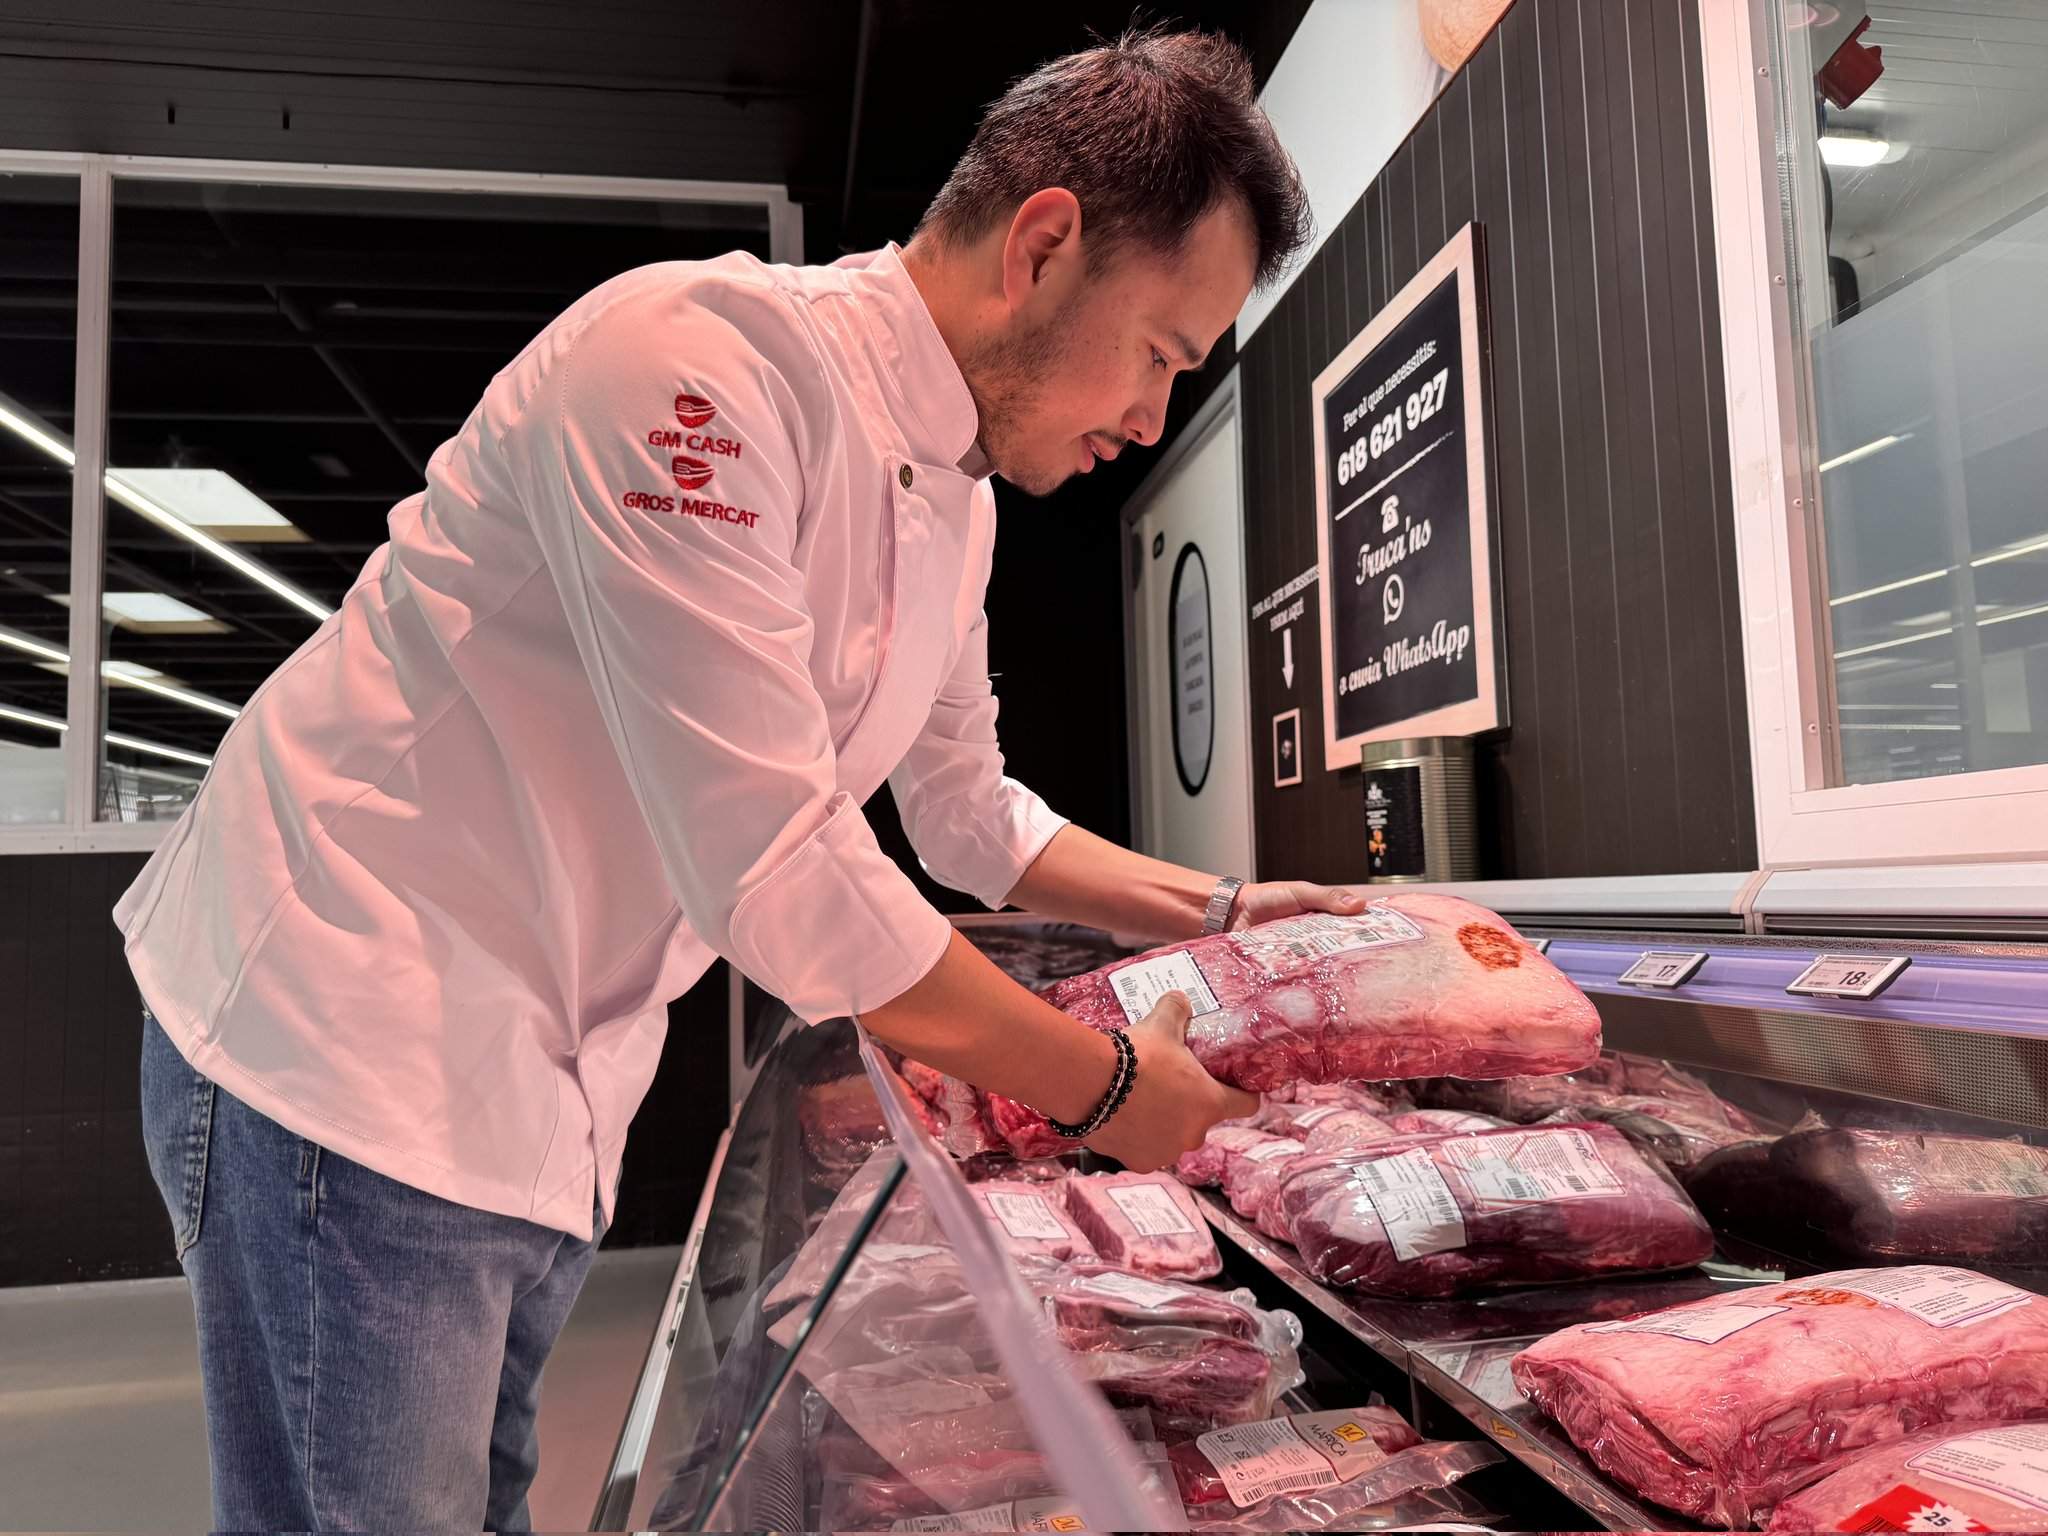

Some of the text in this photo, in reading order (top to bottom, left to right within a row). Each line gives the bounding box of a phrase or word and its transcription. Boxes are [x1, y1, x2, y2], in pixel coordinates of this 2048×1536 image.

[1358, 396, 1369, 419] al
[1368, 384, 1385, 412] que
[648, 430, 742, 459] GM CASH
[1337, 367, 1449, 486] 618 621 927
[623, 491, 760, 529] GROS MERCAT
[1356, 515, 1432, 585] Truca'ns
[1349, 657, 1382, 692] envia
[1383, 619, 1470, 678] WhatsApp
[1922, 1511, 1953, 1527] 25
